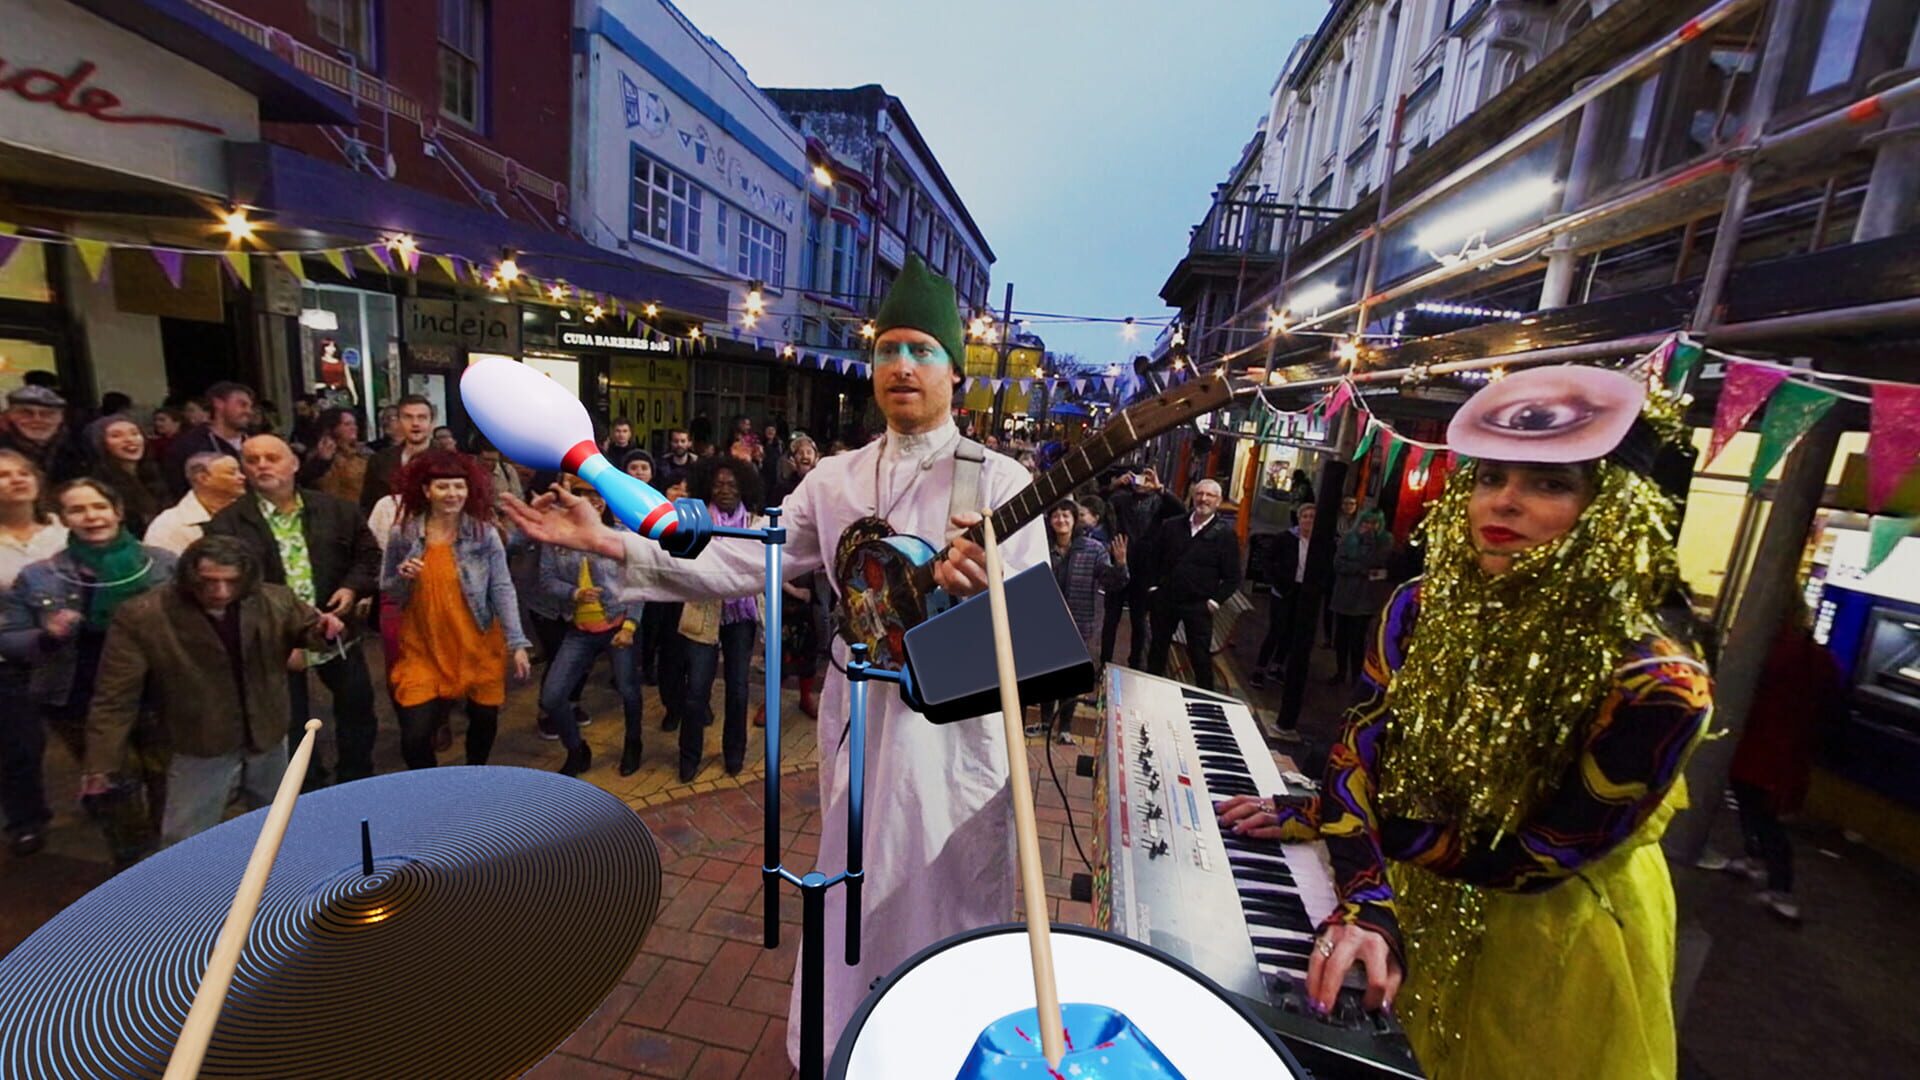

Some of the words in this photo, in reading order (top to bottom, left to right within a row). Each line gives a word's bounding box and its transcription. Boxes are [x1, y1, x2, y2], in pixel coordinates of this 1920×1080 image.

[412, 304, 508, 347] indeja
[562, 332, 593, 346] CUBA
[593, 334, 649, 350] BARBERS
